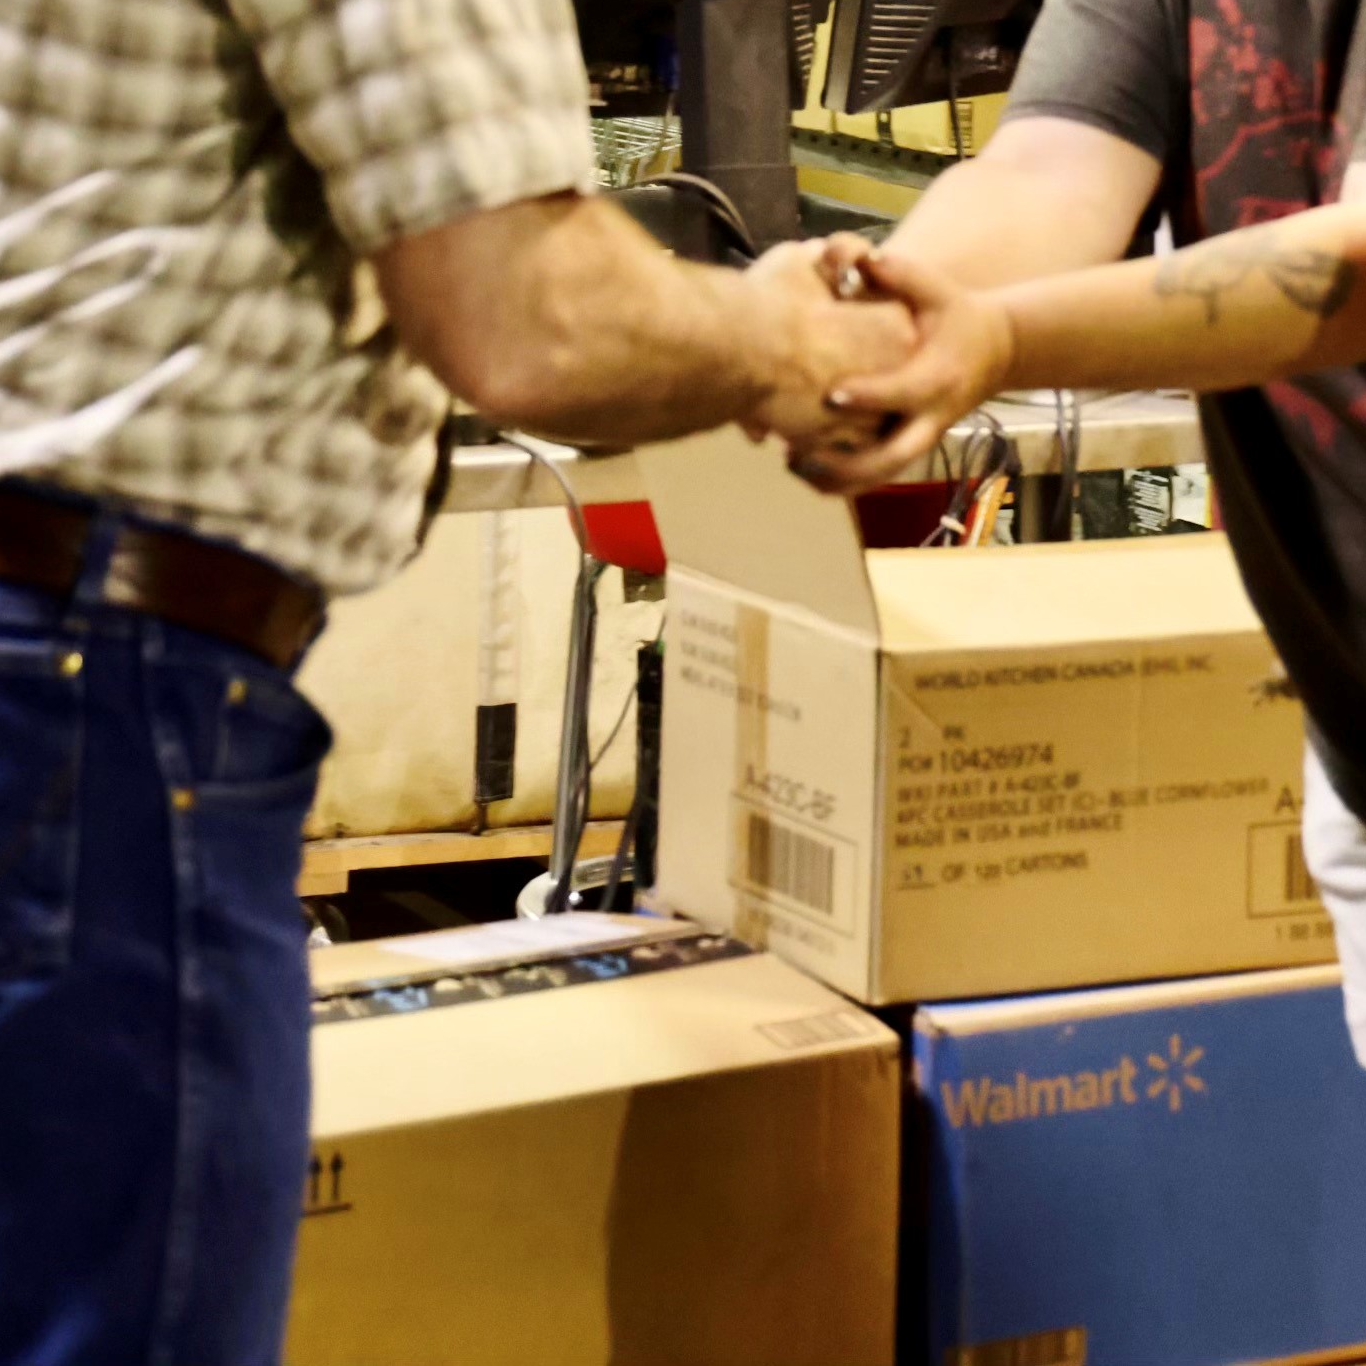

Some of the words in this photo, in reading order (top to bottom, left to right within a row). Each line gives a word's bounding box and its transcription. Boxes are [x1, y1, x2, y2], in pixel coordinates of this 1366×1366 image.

[915, 671, 979, 692] WORLD
[984, 665, 1057, 687] KITCHEN
[1062, 658, 1134, 682] CANADA
[895, 829, 945, 848] MADE
[952, 827, 970, 843] IN
[1056, 813, 1123, 832] FRANCE
[1005, 849, 1088, 877] CARTONS
[941, 1055, 1137, 1128] Walmart
